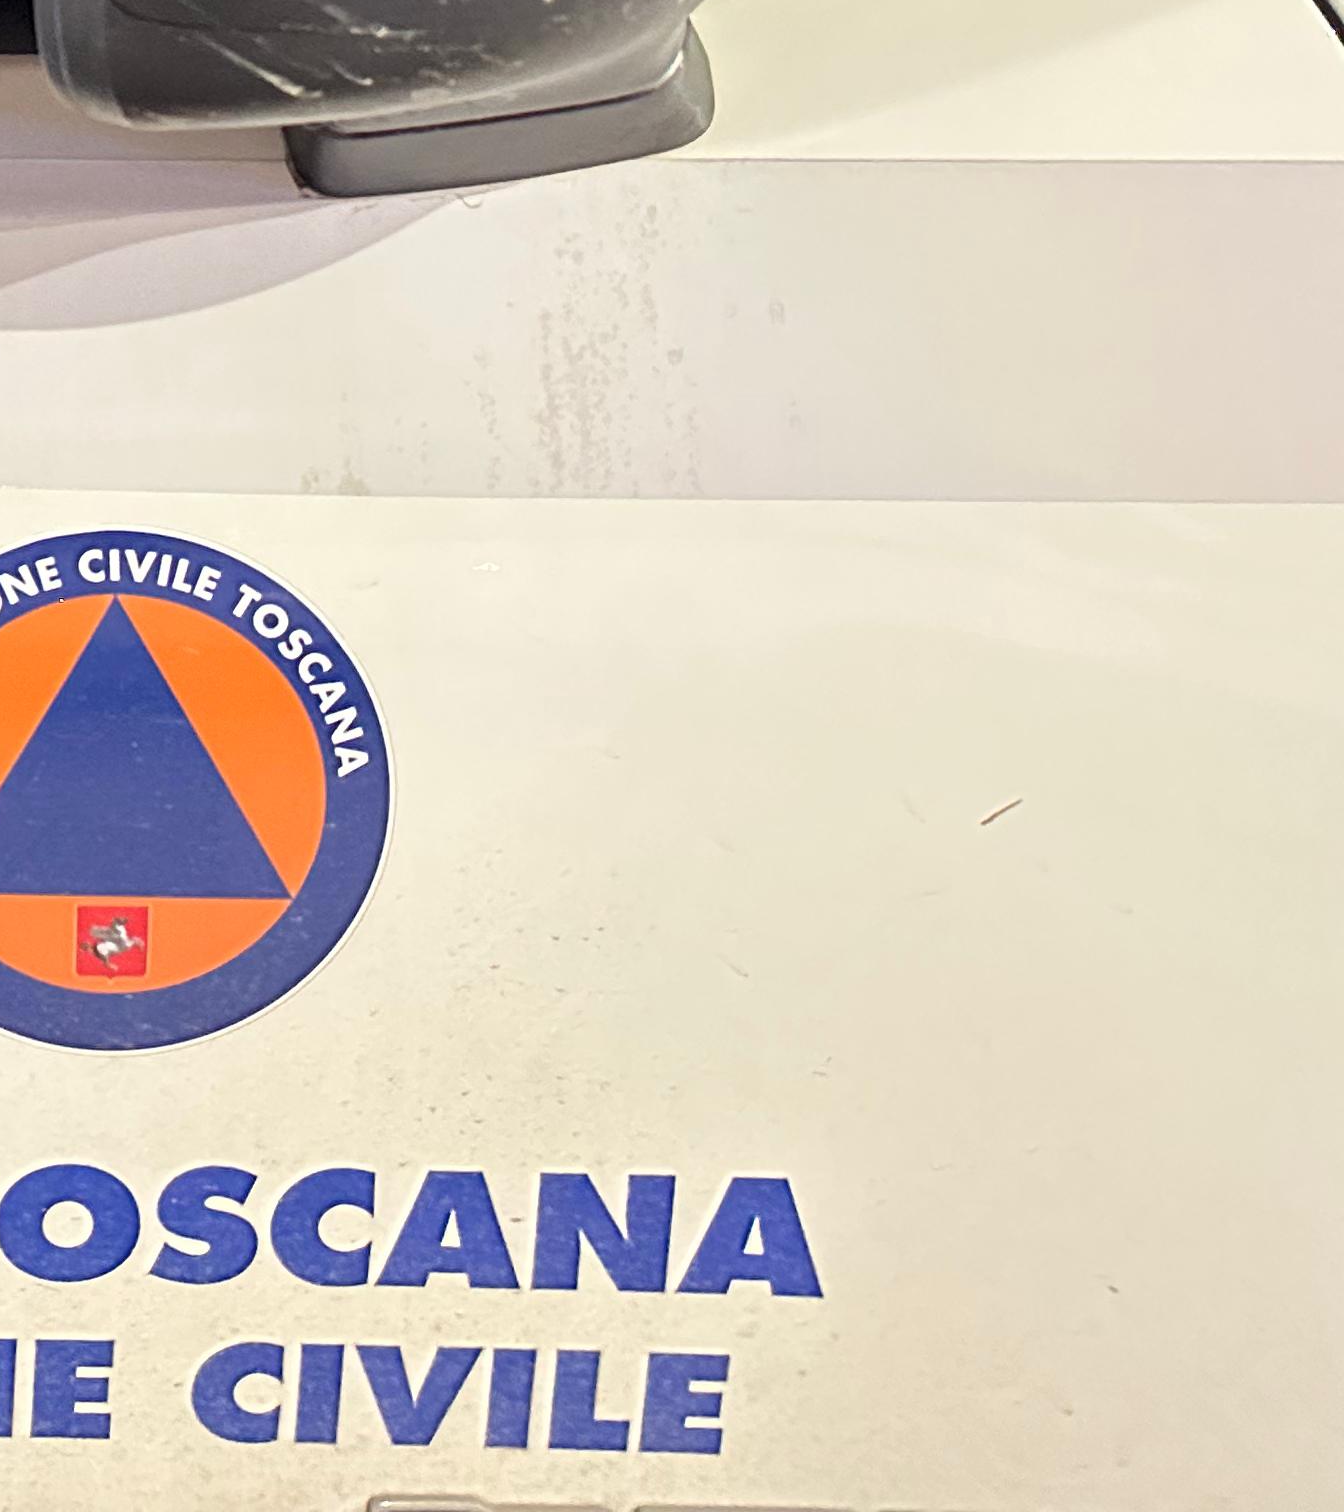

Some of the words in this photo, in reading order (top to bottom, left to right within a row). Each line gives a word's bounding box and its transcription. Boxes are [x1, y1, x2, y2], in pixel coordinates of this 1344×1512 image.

[77, 548, 223, 602] CIVILE
[231, 584, 370, 779] TOSCANA
[191, 1341, 731, 1455] CIVILE
